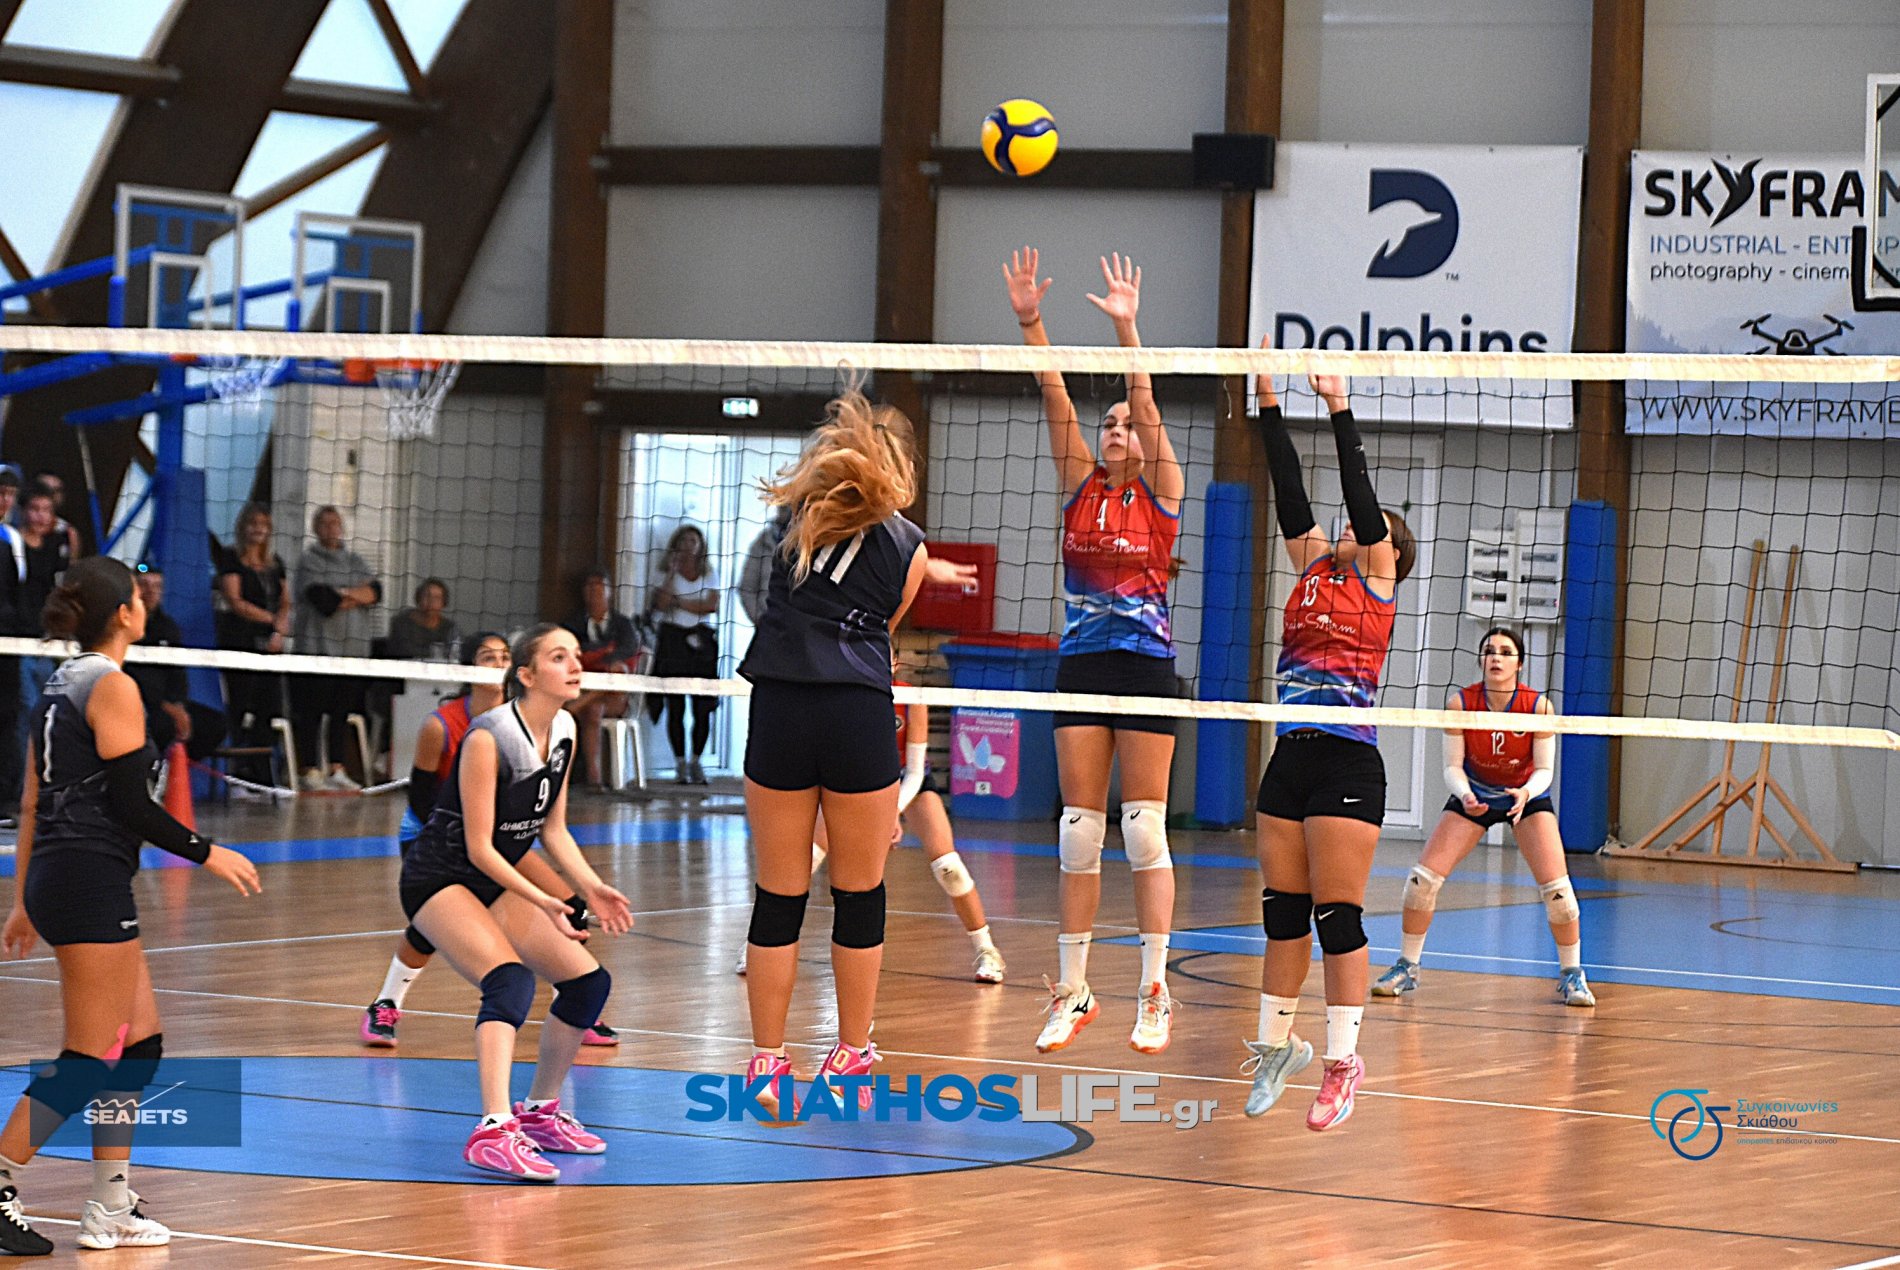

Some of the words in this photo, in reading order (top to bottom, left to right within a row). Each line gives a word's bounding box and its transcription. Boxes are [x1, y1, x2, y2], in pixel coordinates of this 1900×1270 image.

[1650, 235, 1787, 255] INDUSTRIAL
[1650, 262, 1773, 282] photography
[1096, 498, 1108, 531] 4
[1301, 575, 1320, 607] 13
[43, 703, 58, 783] 1
[1491, 731, 1505, 755] 12
[534, 777, 550, 812] 9
